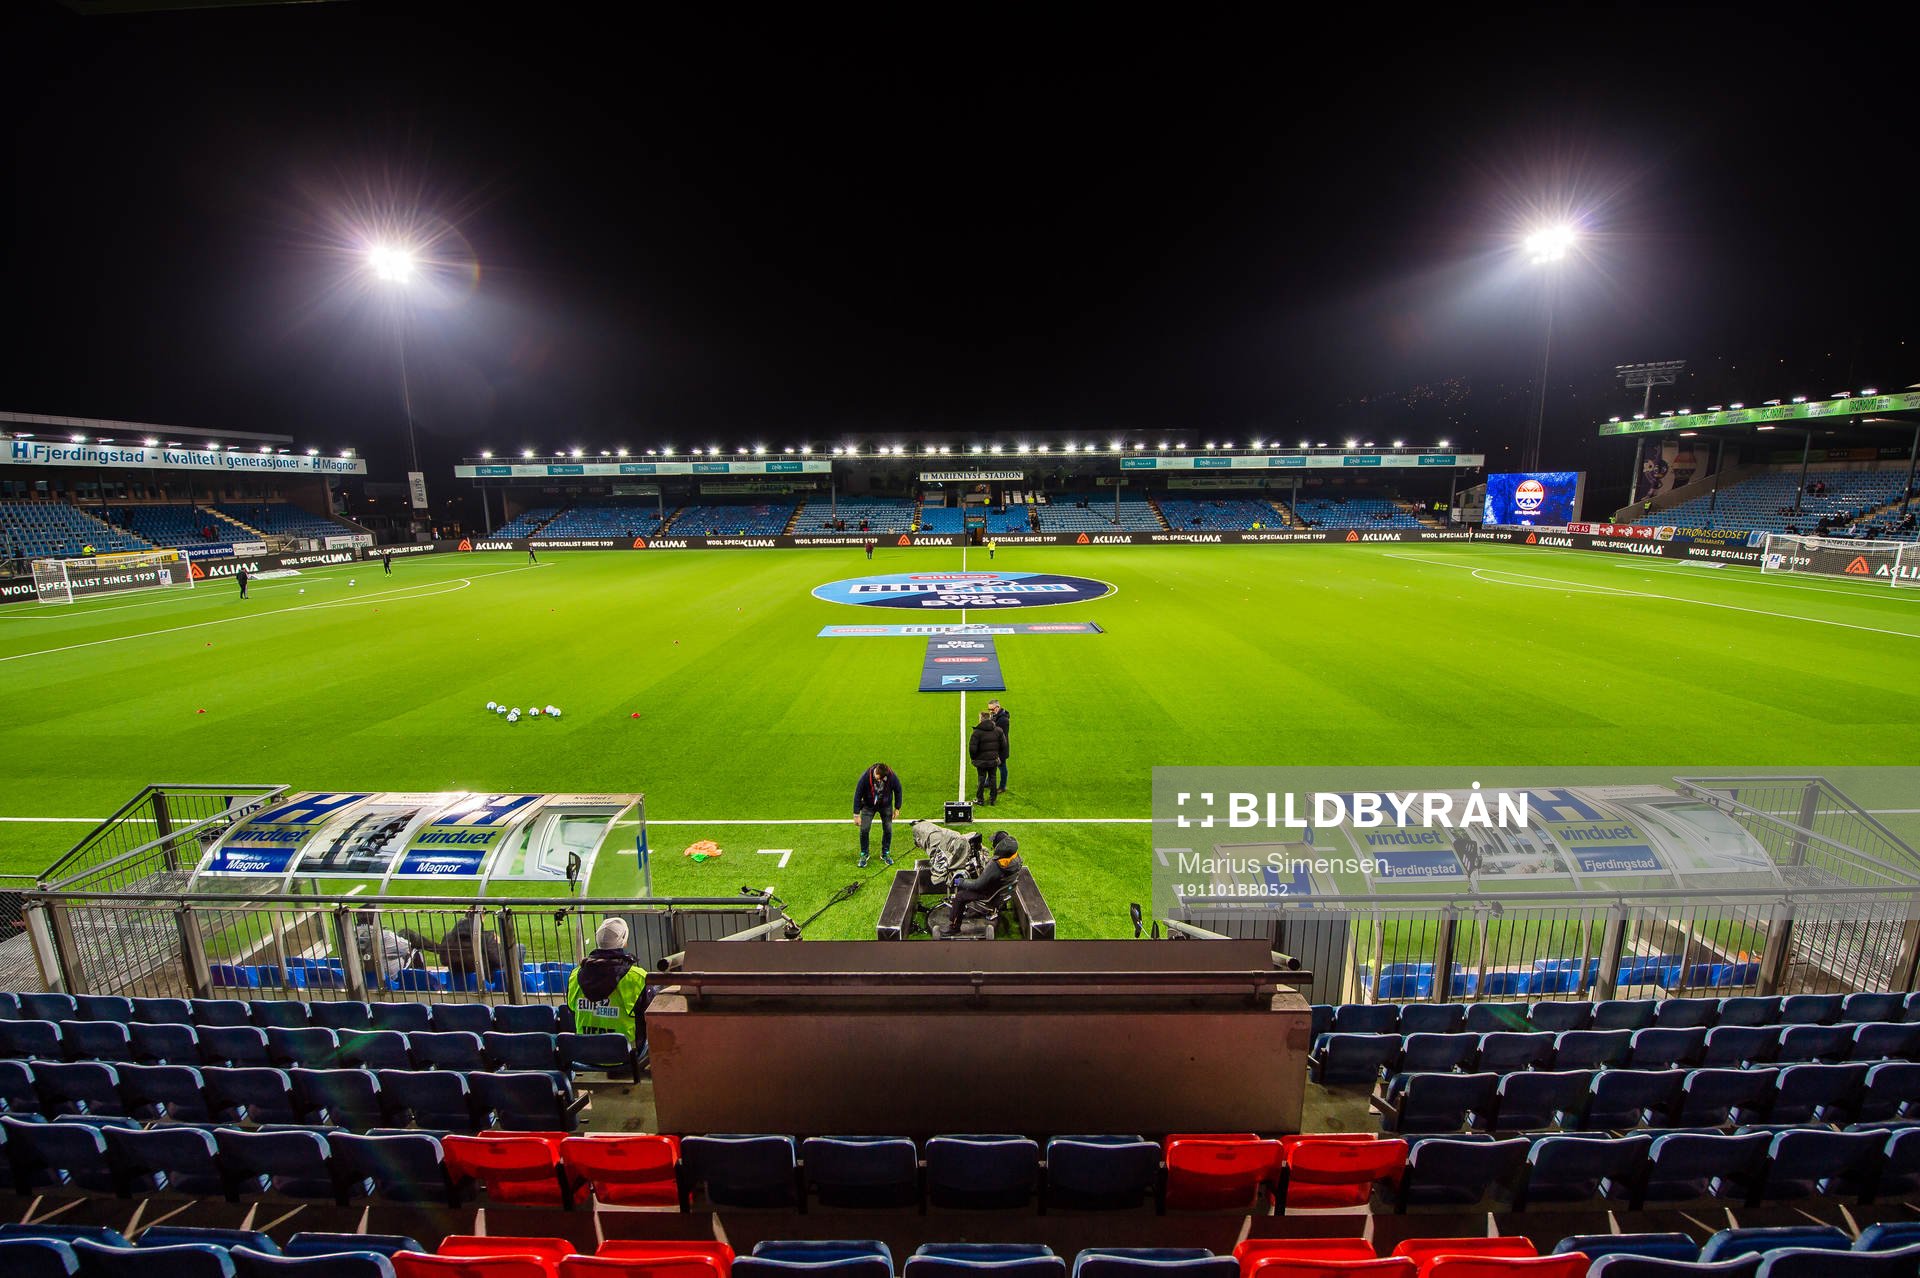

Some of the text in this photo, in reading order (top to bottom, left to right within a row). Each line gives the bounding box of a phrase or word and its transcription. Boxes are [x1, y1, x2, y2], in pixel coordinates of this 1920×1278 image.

[1850, 399, 1877, 411] KIWI
[12, 442, 28, 458] H
[33, 445, 144, 464] Fjerdingstad
[163, 451, 215, 465] Kvalitet
[218, 453, 223, 465] i
[227, 456, 299, 470] generasjoner
[312, 458, 320, 469] H
[322, 459, 358, 472] Magnor
[985, 471, 1021, 479] STADION
[1092, 535, 1132, 543] ACLIMA
[1362, 533, 1401, 541] ACLIMA
[1676, 527, 1749, 540] STRØMSGODSET
[476, 542, 512, 550] ACLIMA
[649, 540, 687, 548] ACLIMA
[1539, 537, 1573, 547] ACLIMA
[1592, 540, 1608, 548] WOOL
[1689, 548, 1709, 557] WOOL
[1711, 549, 1759, 561] SPECIALIST
[280, 558, 299, 566] WOOL
[1789, 556, 1811, 566] 1939
[209, 562, 259, 577] ACLIMA
[1875, 564, 1920, 579] ACLI
[1, 585, 37, 596] WOOL
[103, 574, 133, 585] SINCE
[135, 572, 156, 582] 1939
[859, 583, 953, 592] ELITE
[230, 827, 311, 842] vinduet
[416, 829, 497, 845] vinduet
[1364, 827, 1444, 846] vinduet
[1558, 825, 1638, 841] vinduet
[226, 859, 270, 872] Magnor
[416, 862, 462, 874] Magnor
[1386, 862, 1457, 878] Fjerdingstad
[1583, 859, 1656, 872] Fjerdingstad
[578, 998, 598, 1010] ELITE
[596, 1007, 619, 1017] SERIEN
